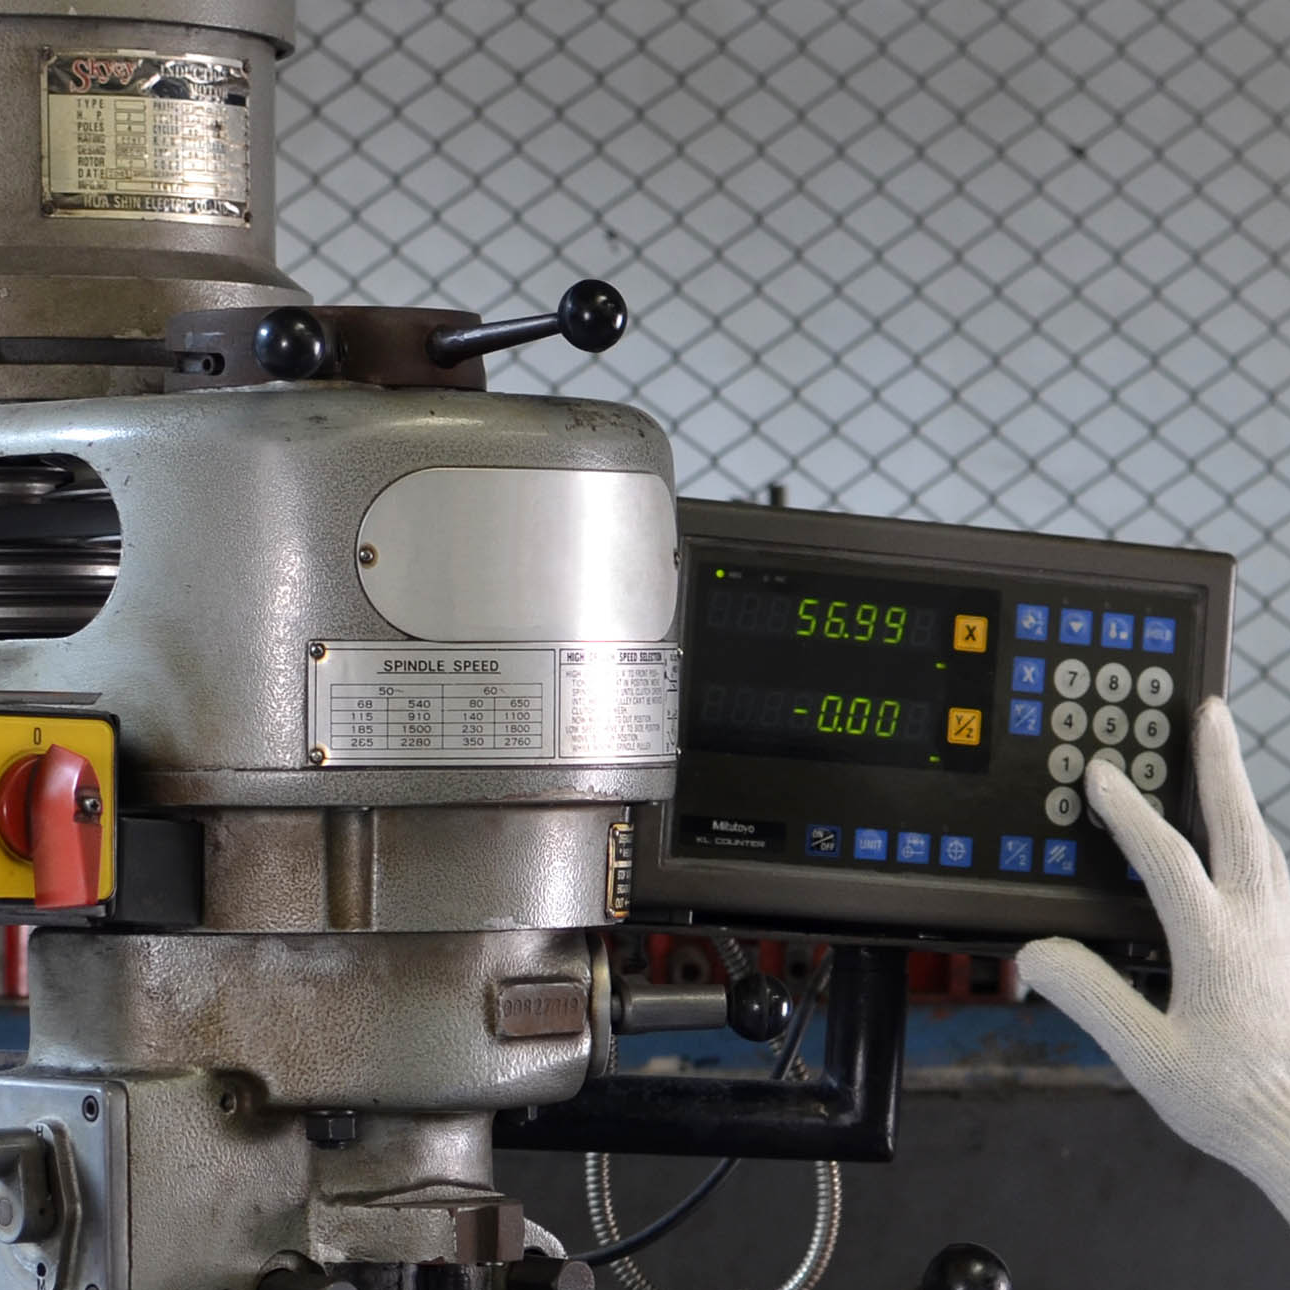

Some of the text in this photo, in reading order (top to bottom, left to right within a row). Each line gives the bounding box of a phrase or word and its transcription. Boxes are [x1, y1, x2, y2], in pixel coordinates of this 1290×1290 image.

[77, 99, 104, 109] TYPE
[77, 122, 105, 132] POLES
[77, 157, 105, 167] ROTOR
[84, 194, 109, 208] HUA
[114, 196, 141, 210] SHIN
[797, 598, 907, 644] 56.99
[964, 624, 977, 642] X
[619, 652, 638, 662] SPEED
[383, 659, 499, 672] SPINDLE SPEED
[1022, 666, 1036, 684] X
[1068, 671, 1160, 695] 7 8 9
[357, 699, 531, 709] 68 540 80 650
[351, 711, 531, 721] 115 910 140 1100
[793, 695, 901, 738] -0.00
[351, 724, 531, 734] 185 1500 230 1800
[1063, 714, 1158, 737] 4 5 6
[33, 727, 42, 745] 0
[401, 738, 431, 747] 2280
[462, 737, 484, 746] 350
[504, 737, 531, 746] 2760
[1062, 756, 1154, 779] 1 3
[1059, 798, 1070, 815] 0
[859, 839, 883, 850] UNIT
